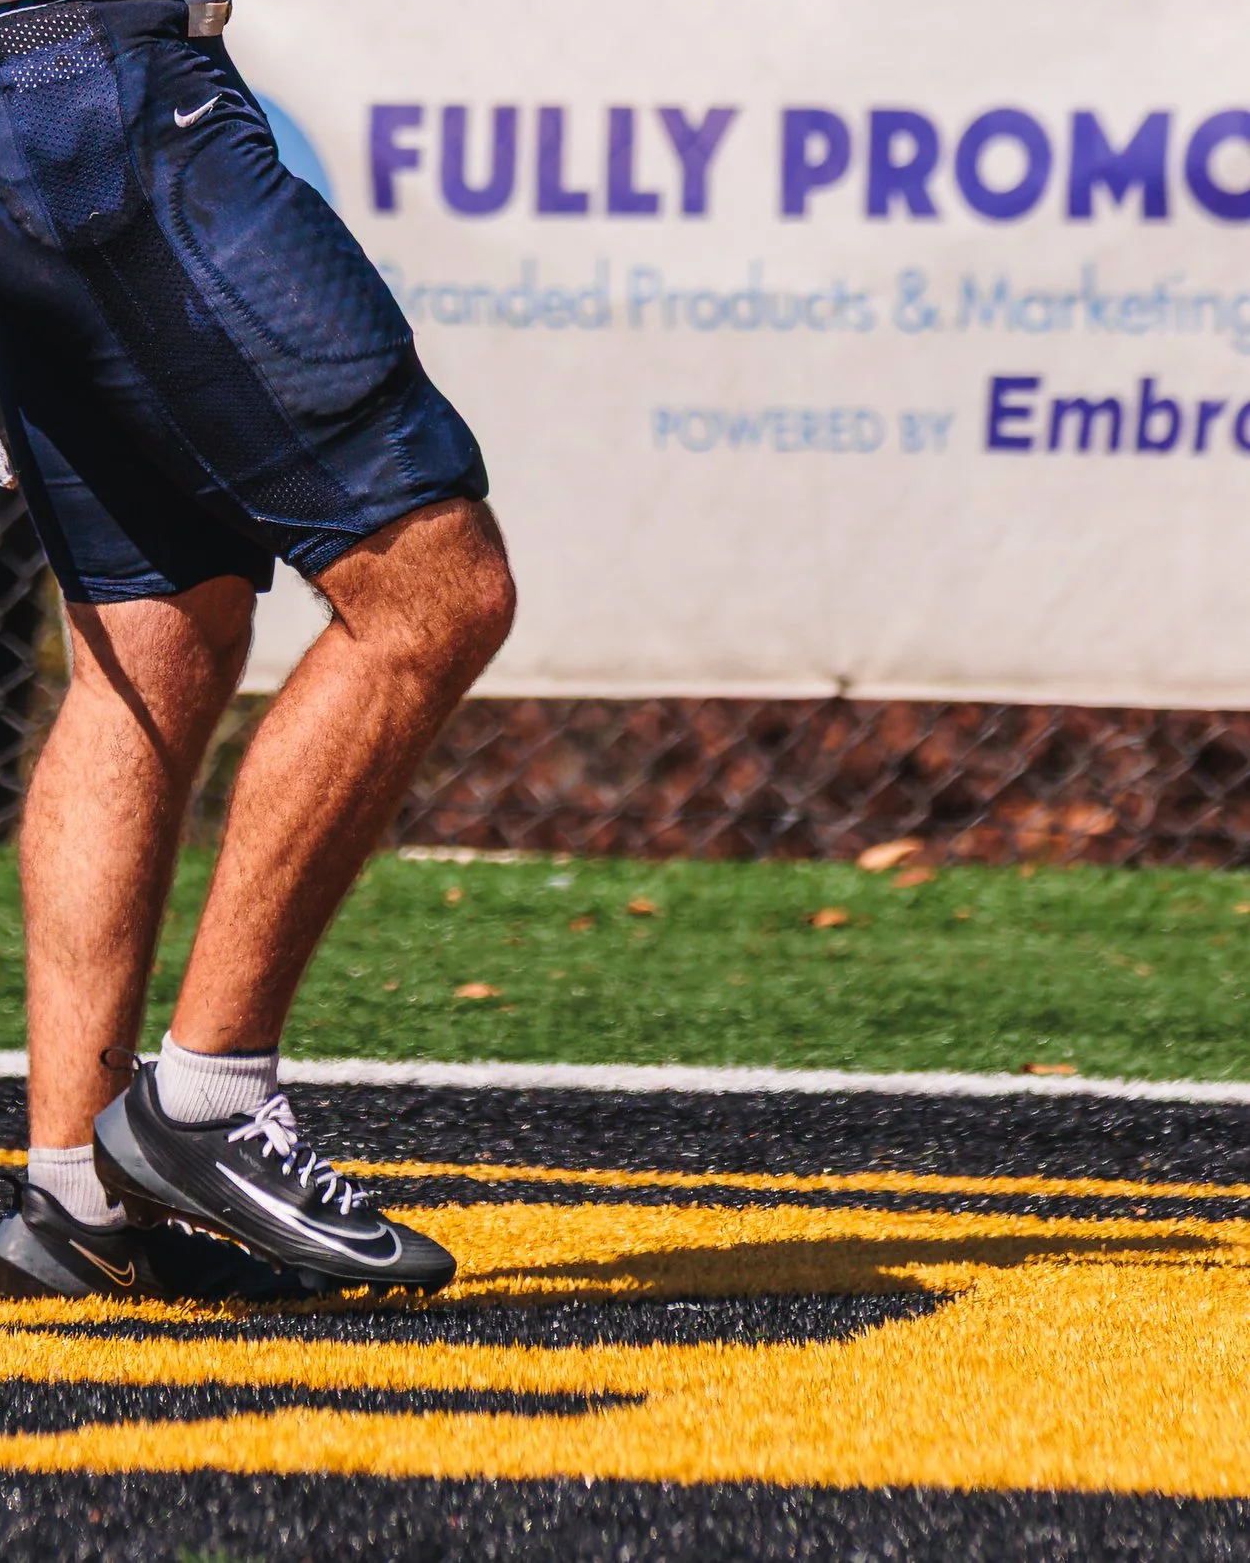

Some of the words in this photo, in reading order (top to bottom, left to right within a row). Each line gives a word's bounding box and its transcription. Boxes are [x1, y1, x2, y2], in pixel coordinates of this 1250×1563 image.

[369, 104, 739, 218] FULLY
[779, 108, 1250, 222] PROMO
[626, 260, 877, 333] Products
[893, 268, 941, 333] &
[652, 407, 886, 452] POWERED
[899, 409, 953, 452] BY
